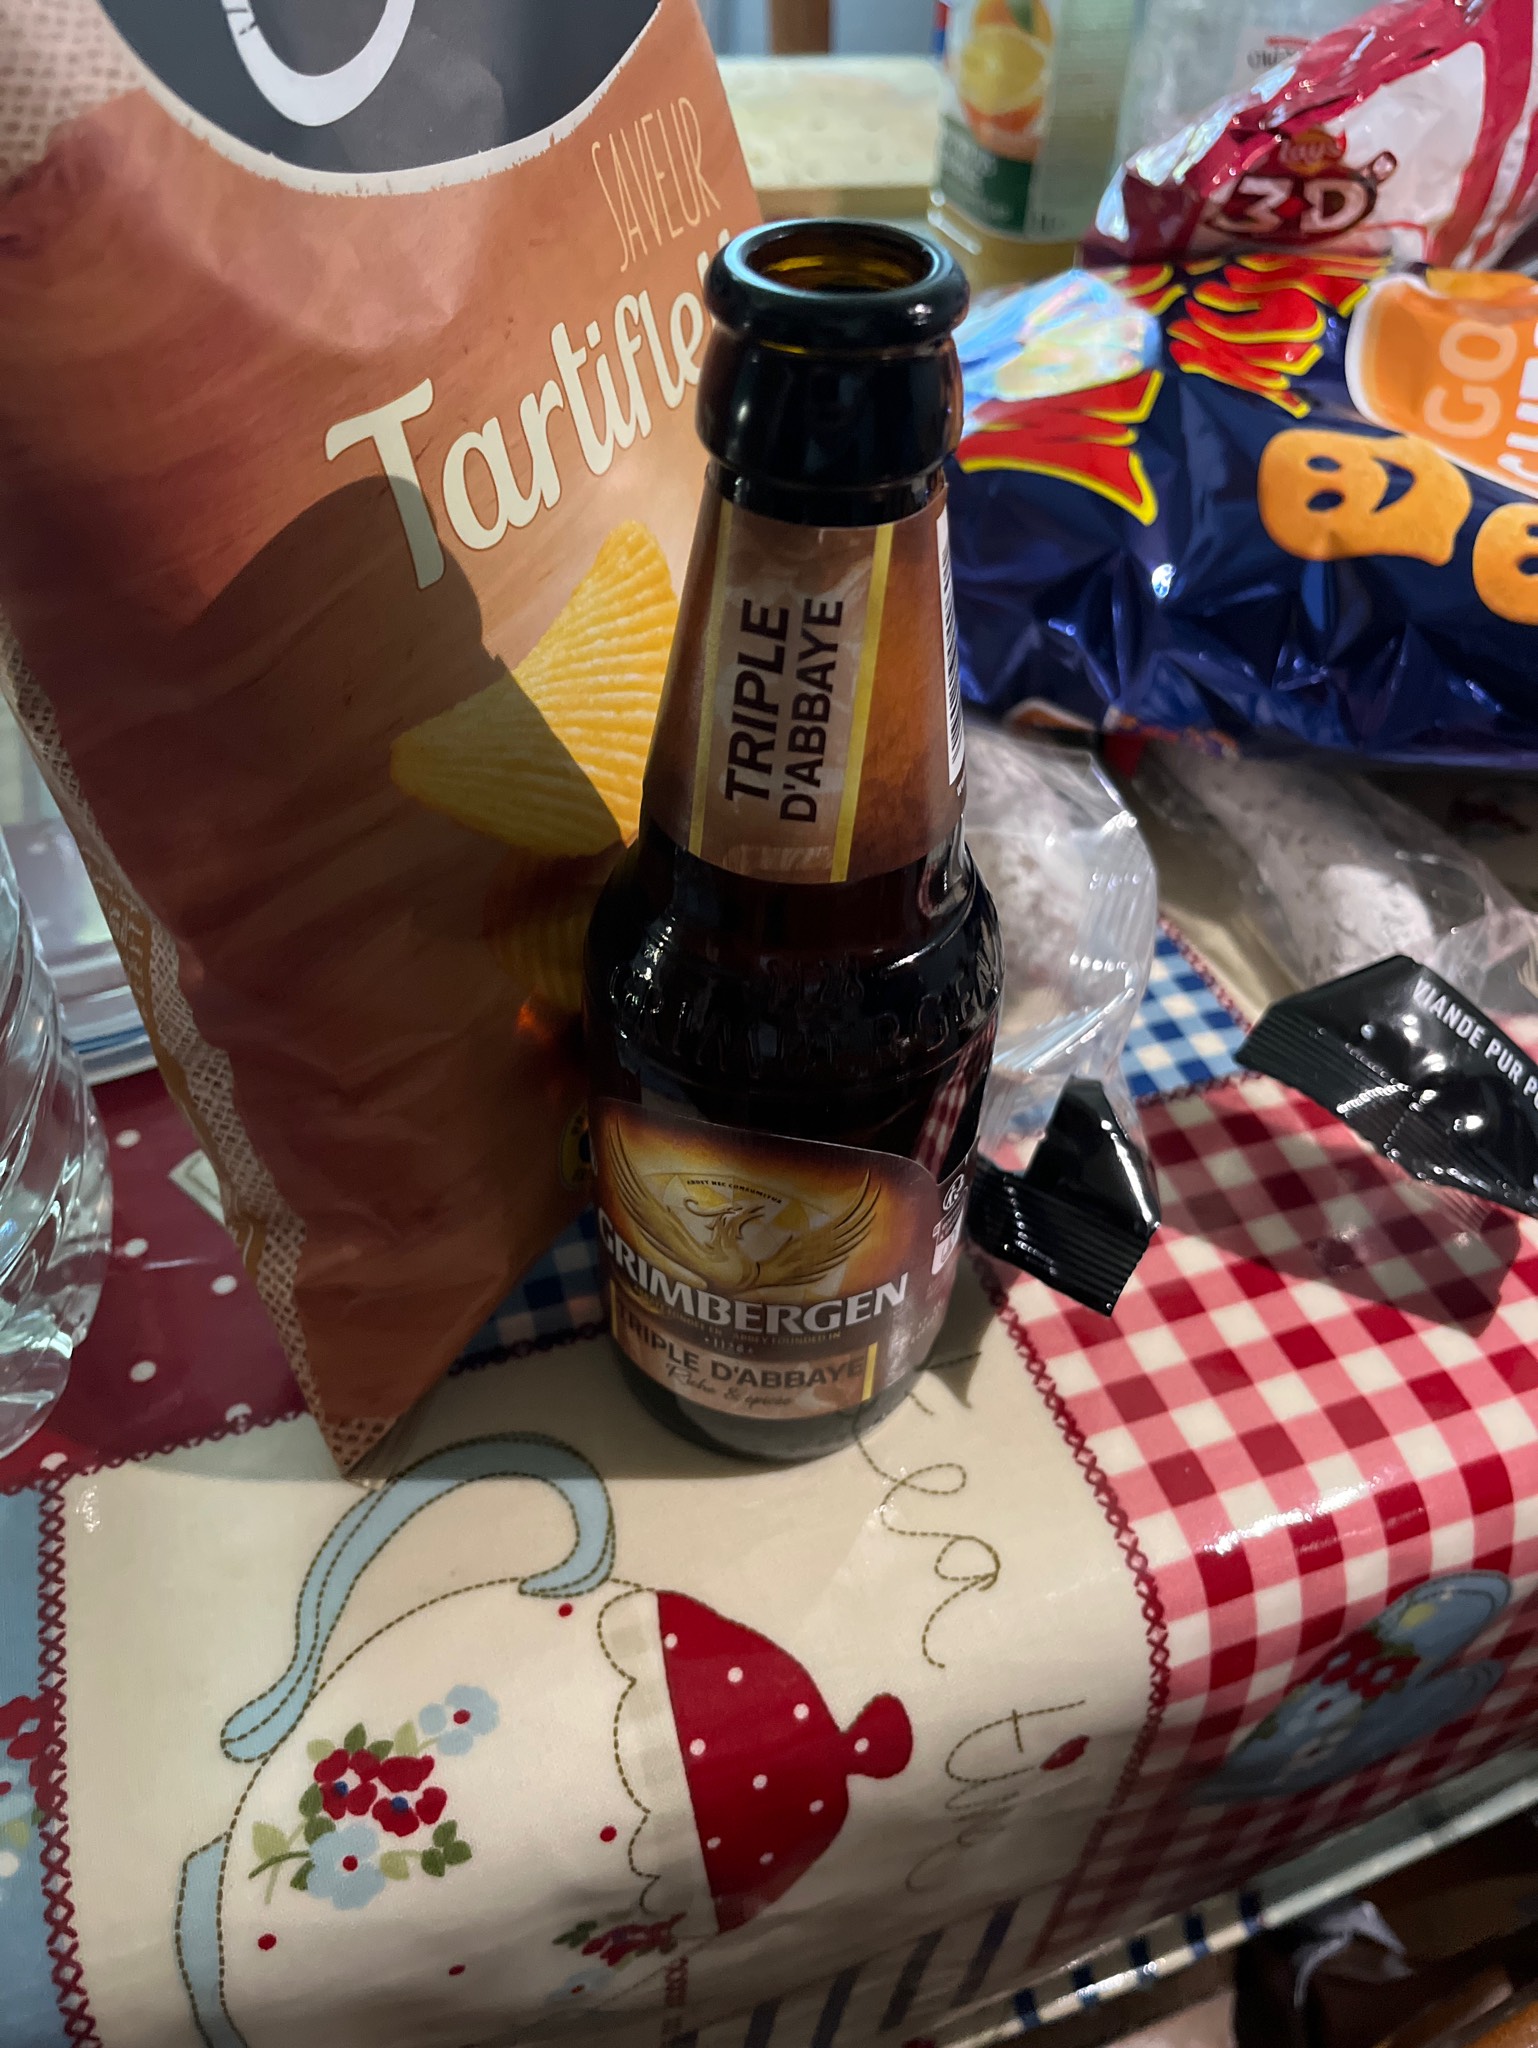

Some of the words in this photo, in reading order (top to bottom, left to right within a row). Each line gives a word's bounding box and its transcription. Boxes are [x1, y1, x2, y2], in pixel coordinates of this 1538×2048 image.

[591, 97, 721, 272] SAVEUR
[324, 228, 730, 590] Tartifle
[725, 598, 789, 802] TRIPLE
[780, 598, 844, 823] D'ABBAYE
[1412, 977, 1487, 1049] VIANDE
[1485, 1038, 1522, 1085] PUR
[599, 1207, 908, 1335] GRIMBERGEN
[710, 1353, 867, 1390] D'ABBAYE
